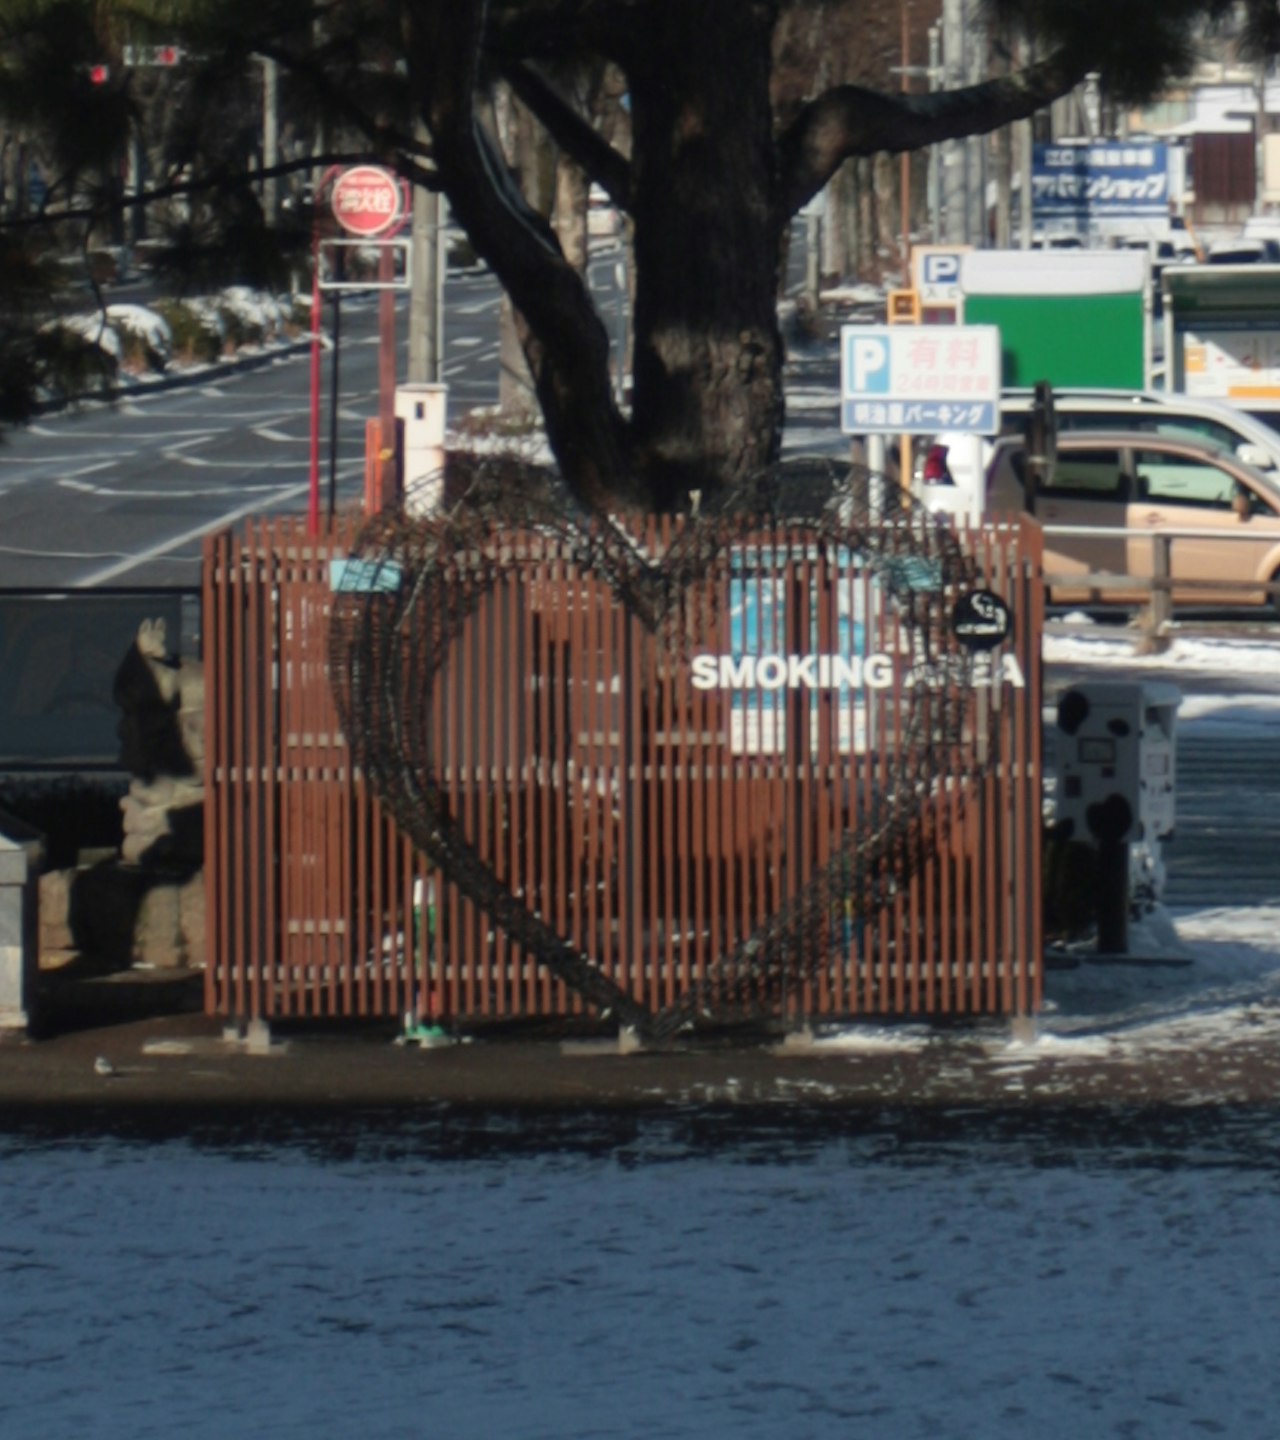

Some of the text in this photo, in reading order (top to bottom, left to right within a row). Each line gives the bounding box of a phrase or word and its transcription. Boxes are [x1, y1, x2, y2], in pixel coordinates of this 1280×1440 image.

[340, 188, 392, 213] 消火栓
[929, 256, 958, 282] P
[853, 338, 886, 390] P
[907, 336, 980, 369] 有料
[691, 655, 894, 689] SMOKING
